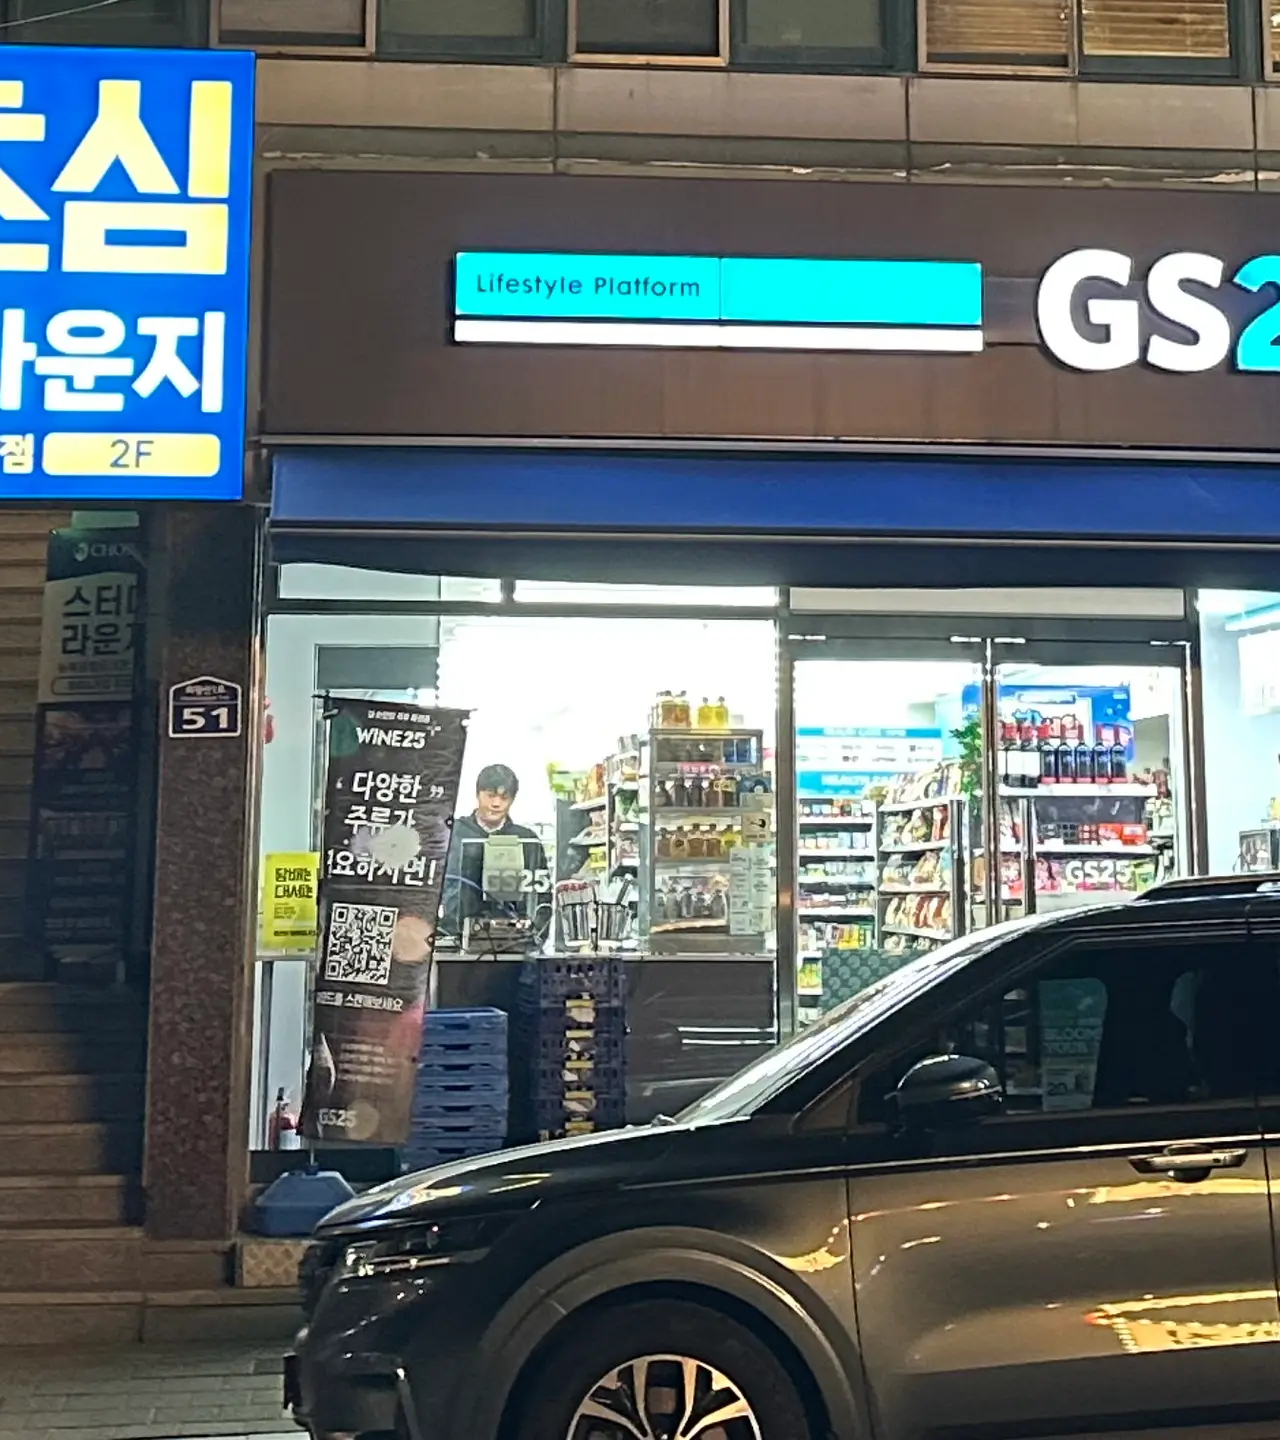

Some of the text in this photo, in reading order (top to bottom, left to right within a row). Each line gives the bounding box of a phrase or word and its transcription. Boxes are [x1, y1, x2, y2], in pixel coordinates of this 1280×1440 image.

[475, 273, 701, 299] Lifestyle Platform
[109, 439, 155, 469] 2F
[181, 706, 229, 731] 51
[1065, 859, 1132, 884] GS25
